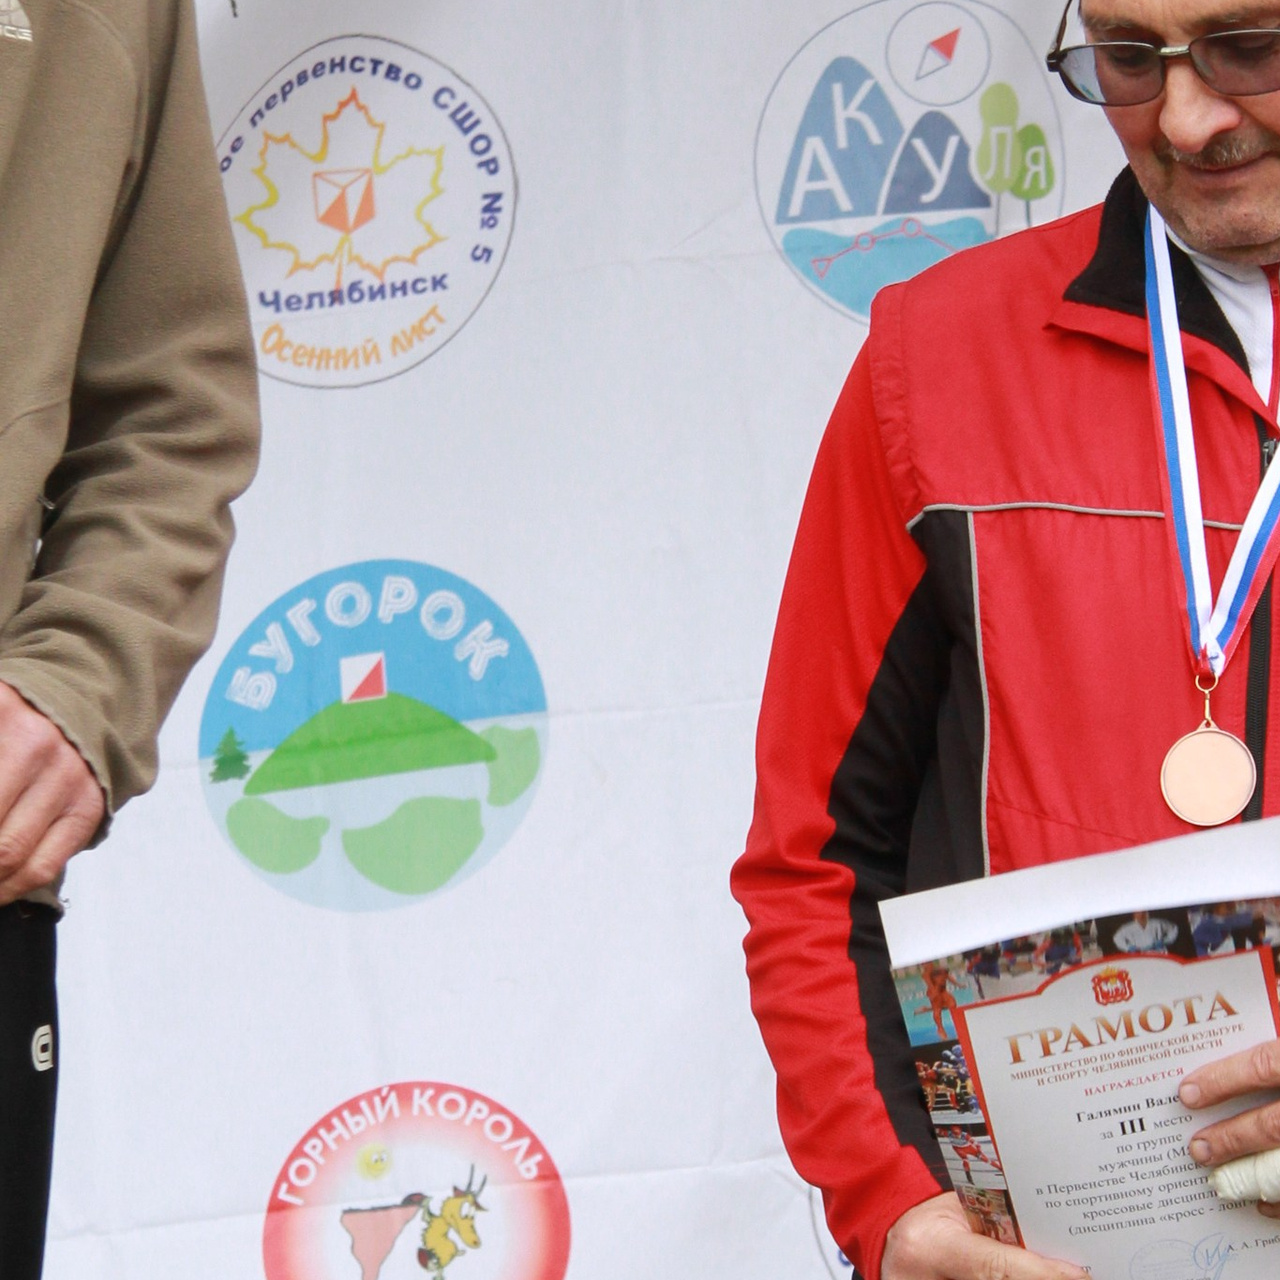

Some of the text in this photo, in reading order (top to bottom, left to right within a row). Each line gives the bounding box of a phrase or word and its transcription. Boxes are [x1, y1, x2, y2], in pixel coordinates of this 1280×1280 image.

[248, 55, 424, 129] первенство
[432, 86, 500, 176] СШОР
[471, 244, 494, 264] 5
[258, 272, 450, 314] Челябинск
[260, 322, 382, 372] Осенний
[225, 574, 510, 711] БУГОРОК
[1006, 990, 1239, 1065] ГРАМОТА
[1010, 1023, 1245, 1081] МИНИСТЕРСТВО ПО ФИЗИЧЕСКОЙ КУЛЬТУРЕ
[1037, 1038, 1223, 1087] И СПОРТУ ЧЕЛЯБИНСКОЙ ОБЛАСТИ
[1084, 1067, 1184, 1097] НАГРАЖДАЕТСЯ
[1076, 1094, 1180, 1123] Галямин Вале
[1100, 1114, 1193, 1141] за III место
[1116, 1133, 1183, 1154] по группе
[277, 1086, 545, 1206] ГОРНЫЙ КОРОЛЬ
[1035, 1161, 1204, 1195] в Первенстве Челябинск
[1098, 1154, 1163, 1173] мужчины
[1045, 1198, 1062, 1209] по
[1065, 1187, 1154, 1208] спортивному
[1082, 1201, 1153, 1221] кроссовые
[1068, 1213, 1157, 1236] (дисциплина
